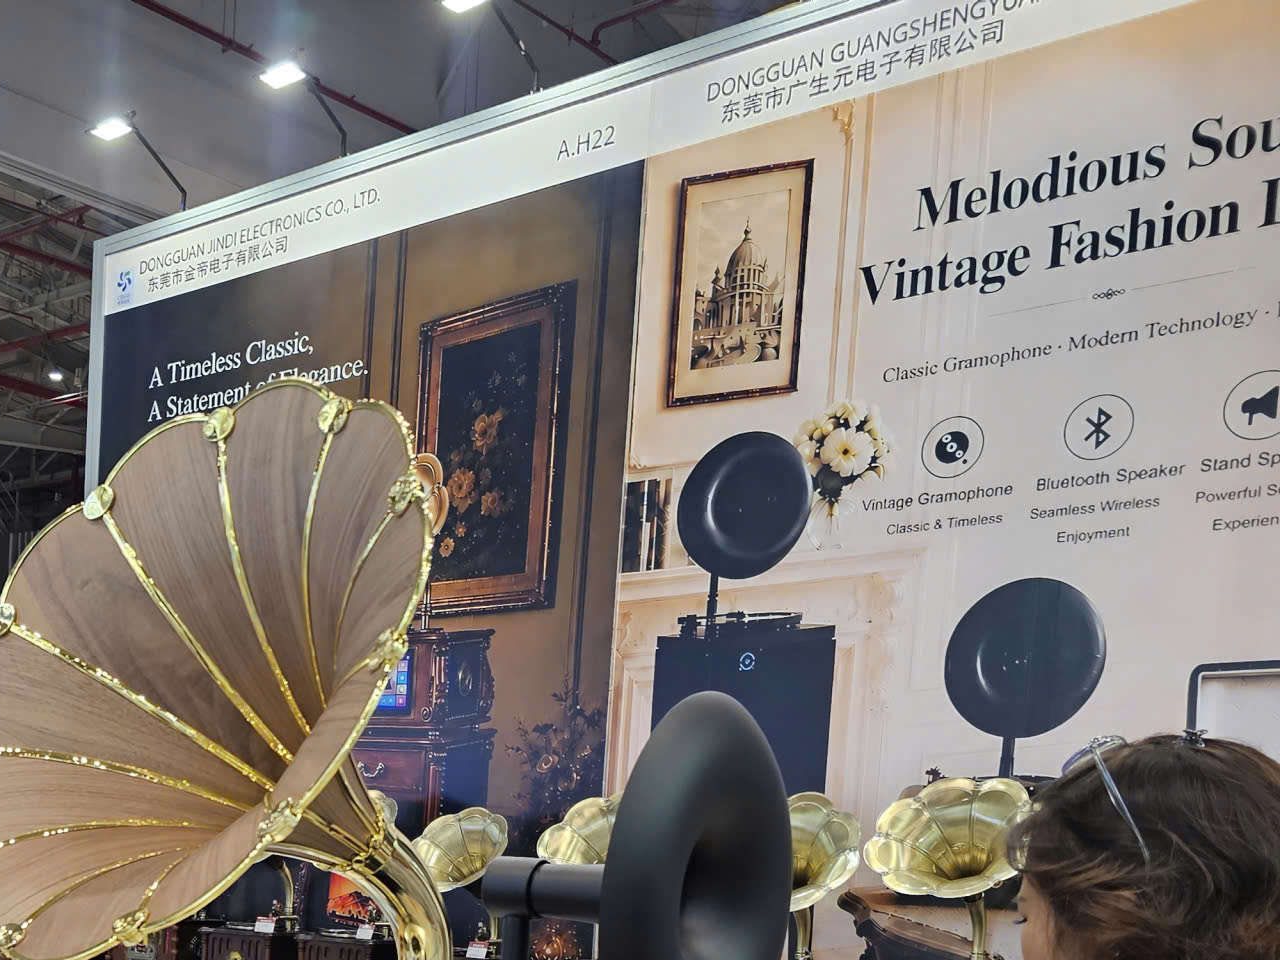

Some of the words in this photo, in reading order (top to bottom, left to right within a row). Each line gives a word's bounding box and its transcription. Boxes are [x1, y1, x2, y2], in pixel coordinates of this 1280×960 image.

[707, 49, 824, 103] DONGGUAN
[831, 0, 1039, 64] GUANGSHENGYU
[721, 20, 1004, 123] 东莞市广生元电子有限公司
[557, 125, 615, 161] A.H22
[912, 143, 1167, 232] Melodious
[139, 242, 205, 275] DONGGUAN
[208, 232, 237, 255] JINDI
[239, 206, 322, 245] ELECTRONICS
[325, 199, 350, 217] CO.,
[353, 188, 381, 210] LTD.
[147, 236, 289, 293] 东莞市金帝电子有限公司
[859, 244, 1031, 306] Vintage
[1045, 199, 1241, 271] Fashion
[148, 366, 164, 389] A
[167, 351, 242, 384] Timeless
[245, 331, 314, 365] Classic,
[882, 361, 938, 384] Classic
[943, 342, 1053, 373] Gramophone
[1068, 328, 1139, 352] Modern
[1146, 309, 1259, 341] Technology
[147, 400, 162, 423] A
[166, 382, 251, 418] Statement
[1036, 471, 1110, 492] Bluetooth
[1116, 464, 1187, 485] Speaker
[1200, 453, 1252, 473] Stand
[862, 496, 913, 512] Vintage
[918, 485, 1014, 506] Gramophone
[1029, 503, 1096, 520] Seamless
[1100, 497, 1161, 513] Wireless
[1195, 485, 1262, 504] Powerful
[886, 521, 931, 536] Classic
[933, 519, 943, 530] &
[947, 514, 1004, 529] Timeless
[1056, 526, 1130, 545] Enjoyment
